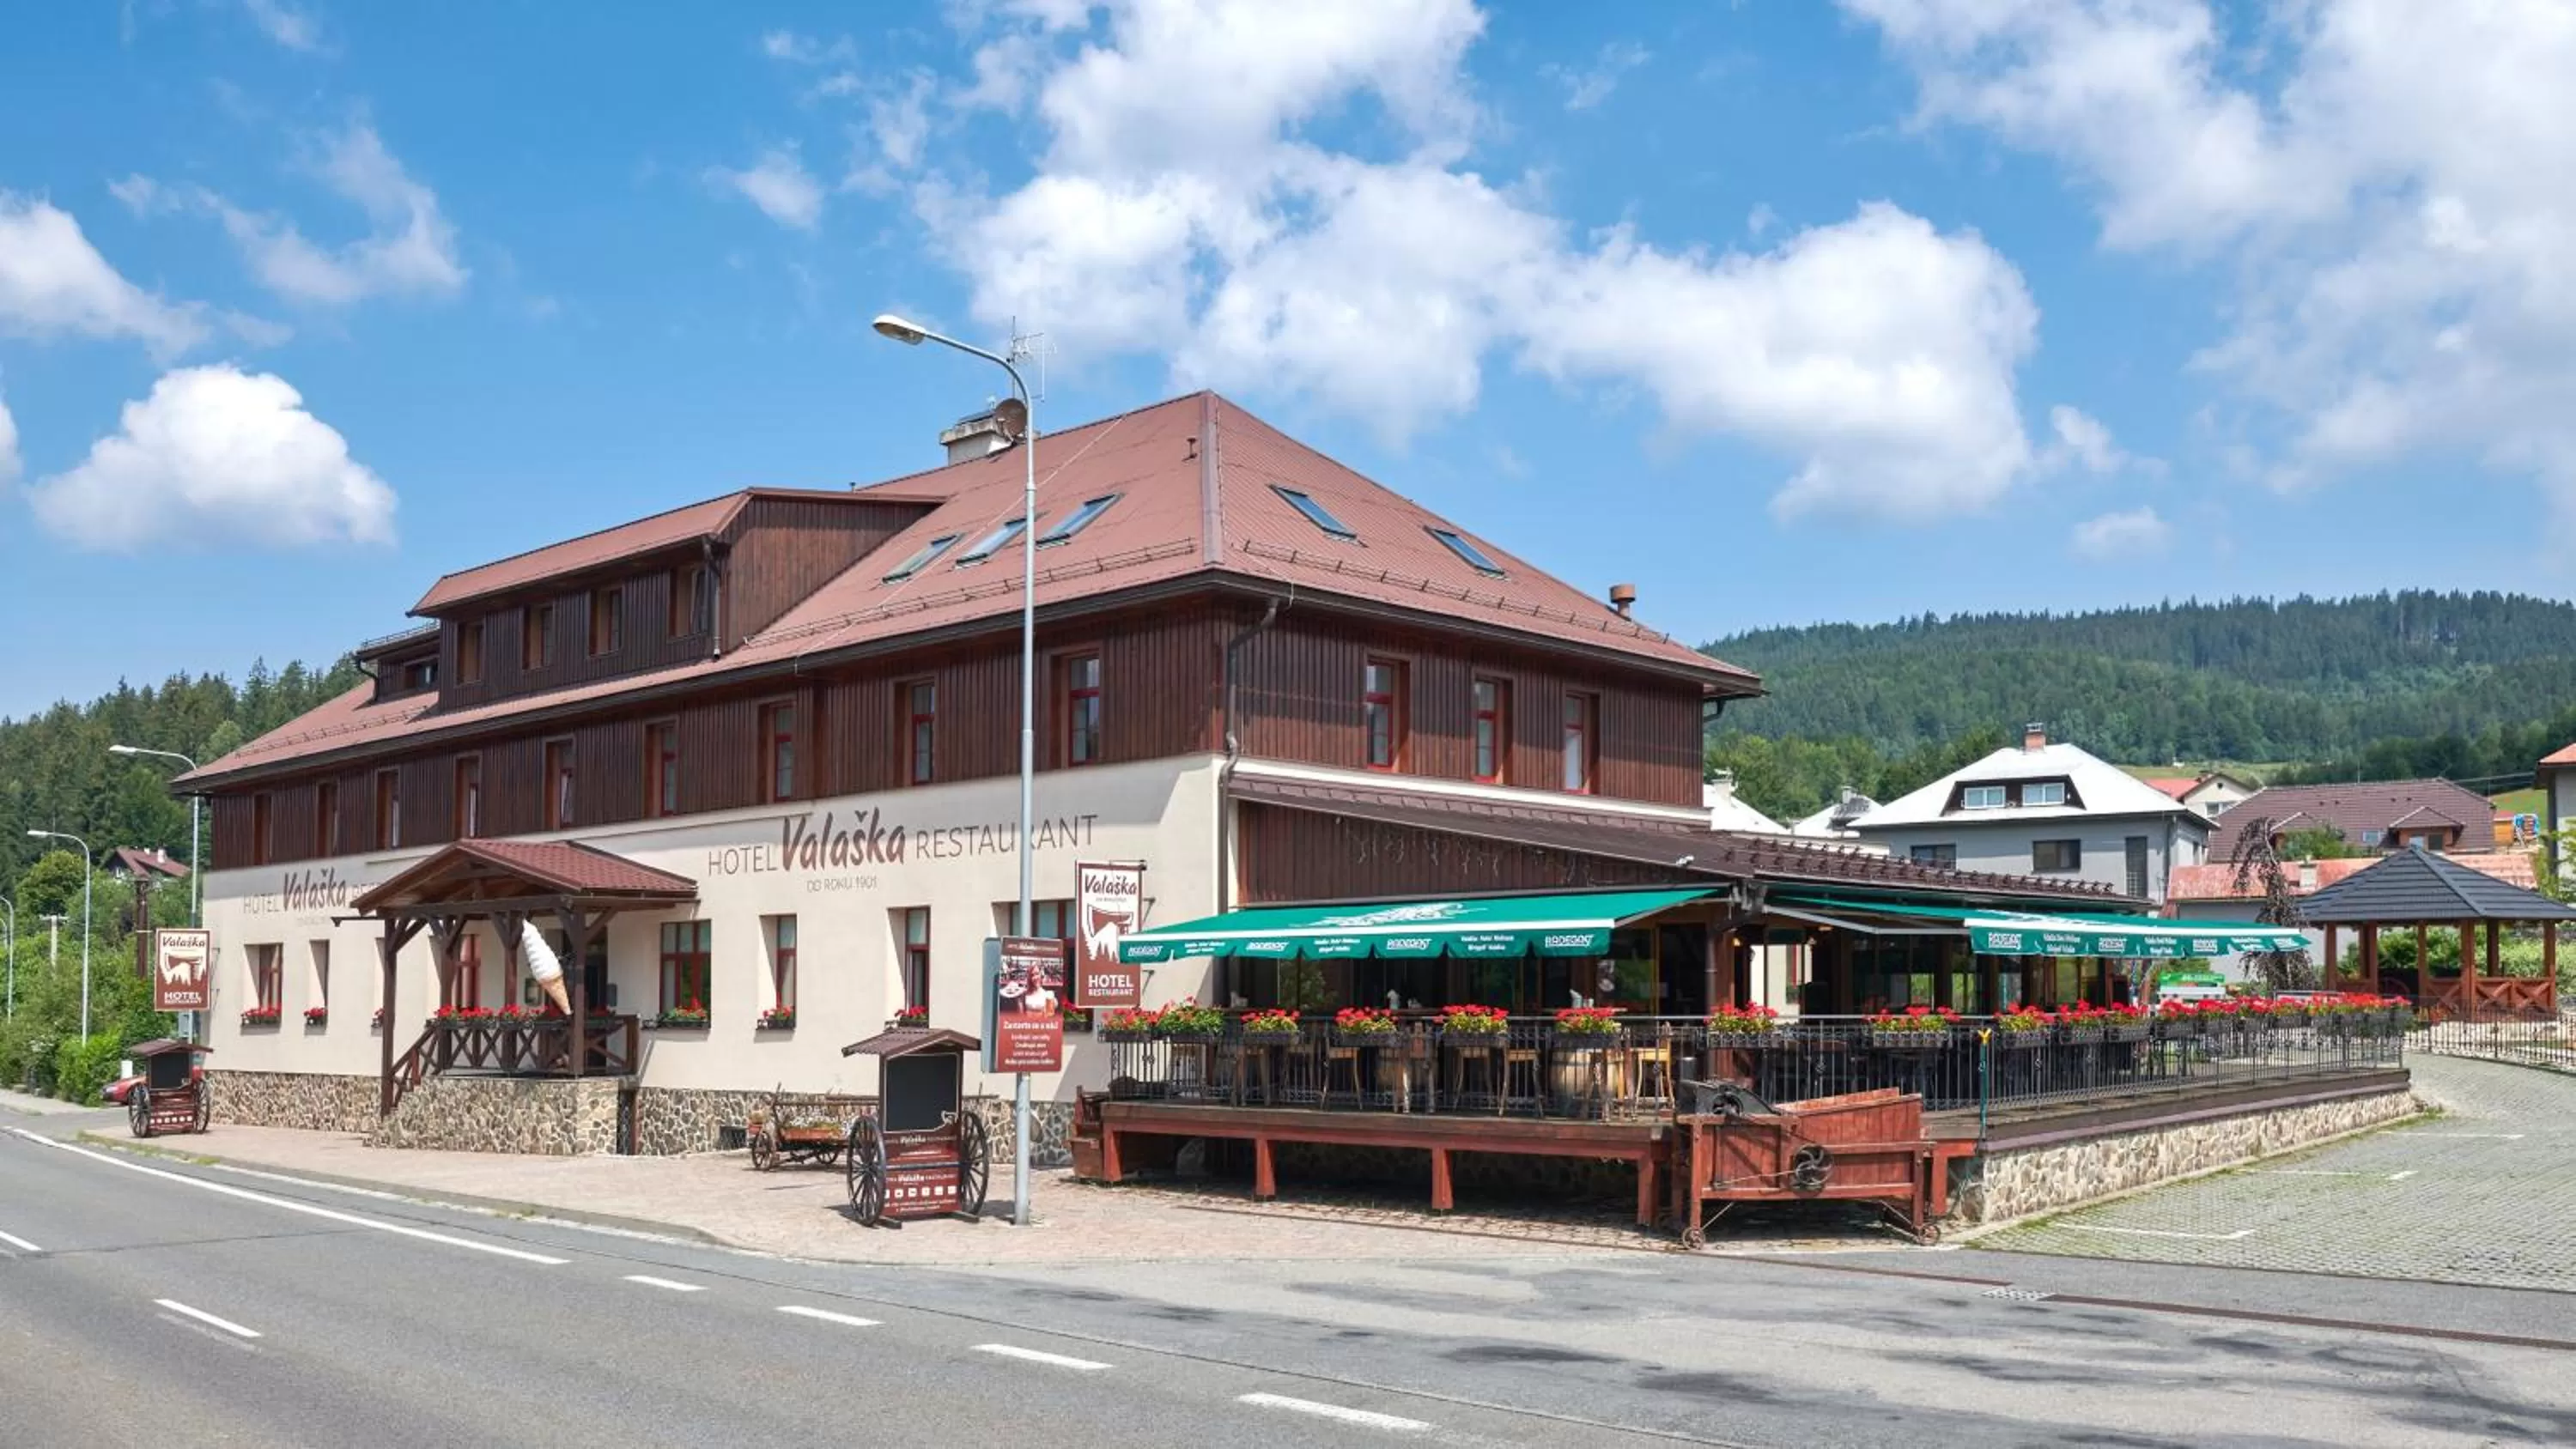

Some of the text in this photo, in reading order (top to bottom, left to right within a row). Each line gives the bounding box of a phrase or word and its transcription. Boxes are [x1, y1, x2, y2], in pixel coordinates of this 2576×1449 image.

[708, 845, 778, 876] HOTEL
[781, 806, 906, 872] Valaška
[243, 892, 280, 914] HOTEL
[283, 866, 347, 912] Valaška
[1084, 873, 1138, 895] Valaška
[162, 936, 205, 948] Valaška
[1088, 975, 1134, 988] HOTEL
[164, 991, 200, 1000] HOTEL
[1088, 988, 1134, 997] RESTAURANT
